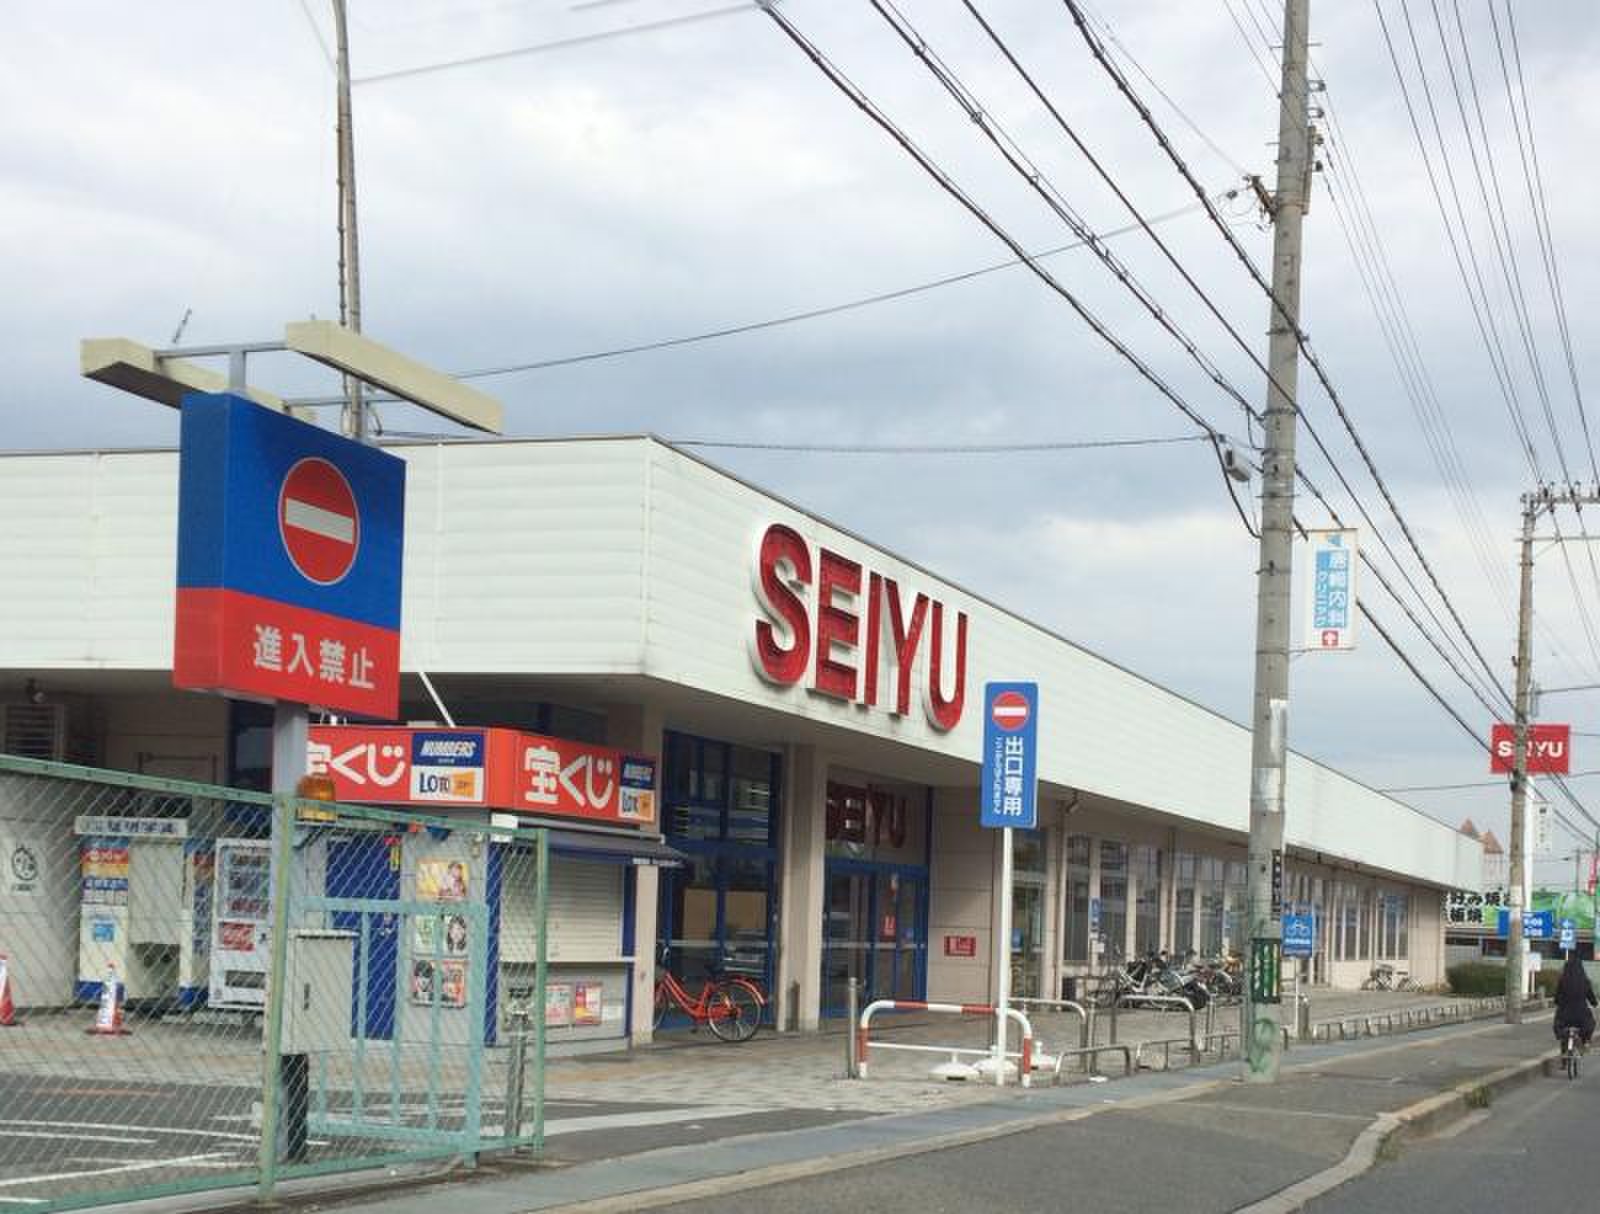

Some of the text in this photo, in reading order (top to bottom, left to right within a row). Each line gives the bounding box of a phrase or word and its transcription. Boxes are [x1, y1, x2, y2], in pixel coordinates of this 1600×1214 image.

[752, 523, 968, 732] SEIYU
[253, 624, 375, 690] 進入禁止
[420, 740, 477, 758] NUMBERS
[1498, 740, 1564, 759] SIYU
[525, 745, 613, 810] 宝くじ
[1440, 889, 1510, 906] 好み焼
